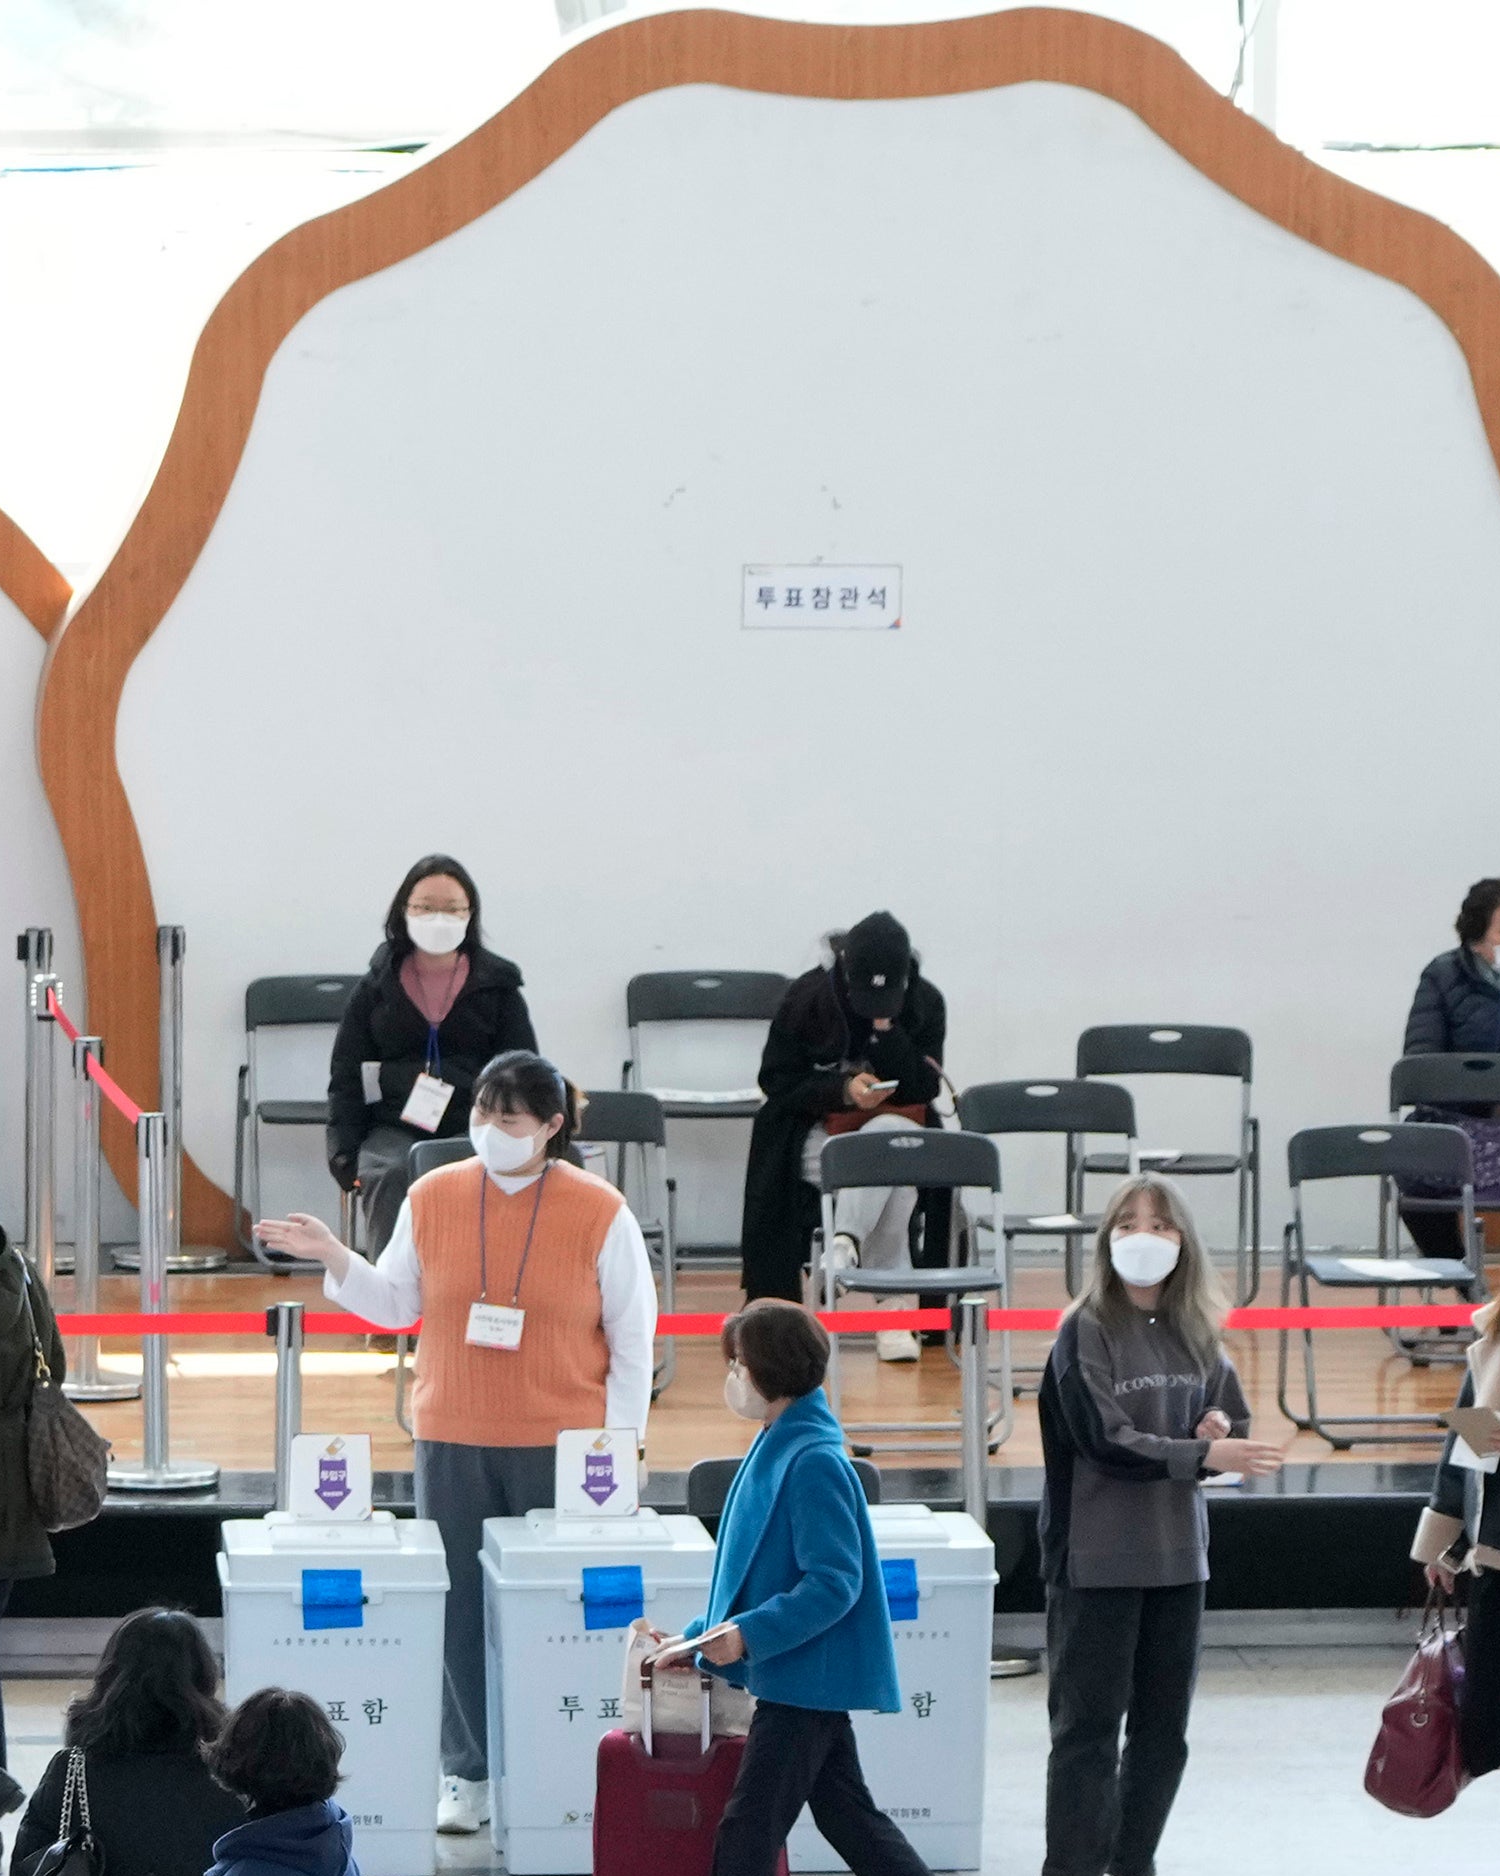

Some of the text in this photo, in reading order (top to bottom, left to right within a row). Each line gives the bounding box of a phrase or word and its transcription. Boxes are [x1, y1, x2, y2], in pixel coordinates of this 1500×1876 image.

[756, 586, 887, 610] 투표참관석
[326, 1698, 388, 1725] 표함
[558, 1696, 623, 1722] 투표
